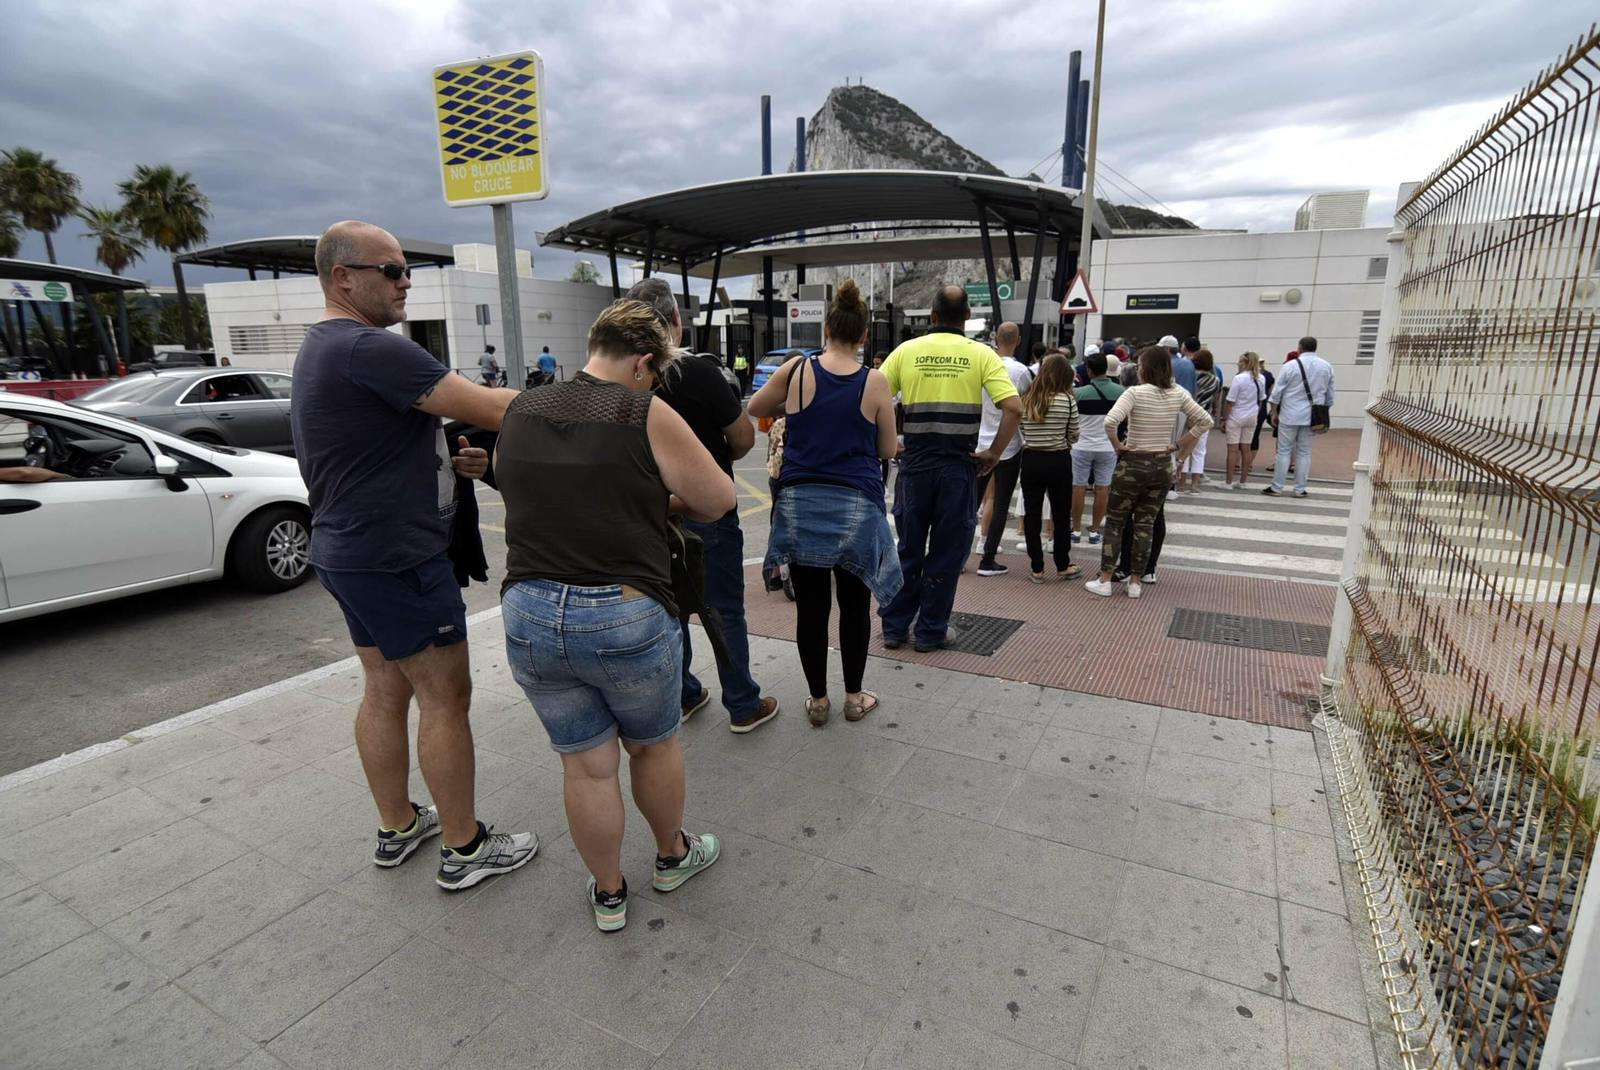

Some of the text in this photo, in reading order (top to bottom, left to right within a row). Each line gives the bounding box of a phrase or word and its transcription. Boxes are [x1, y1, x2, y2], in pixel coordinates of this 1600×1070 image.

[450, 157, 534, 180] NO BLOQUEAR
[473, 176, 513, 193] CRUCE
[914, 356, 971, 366] SOFYCOM LTD.
